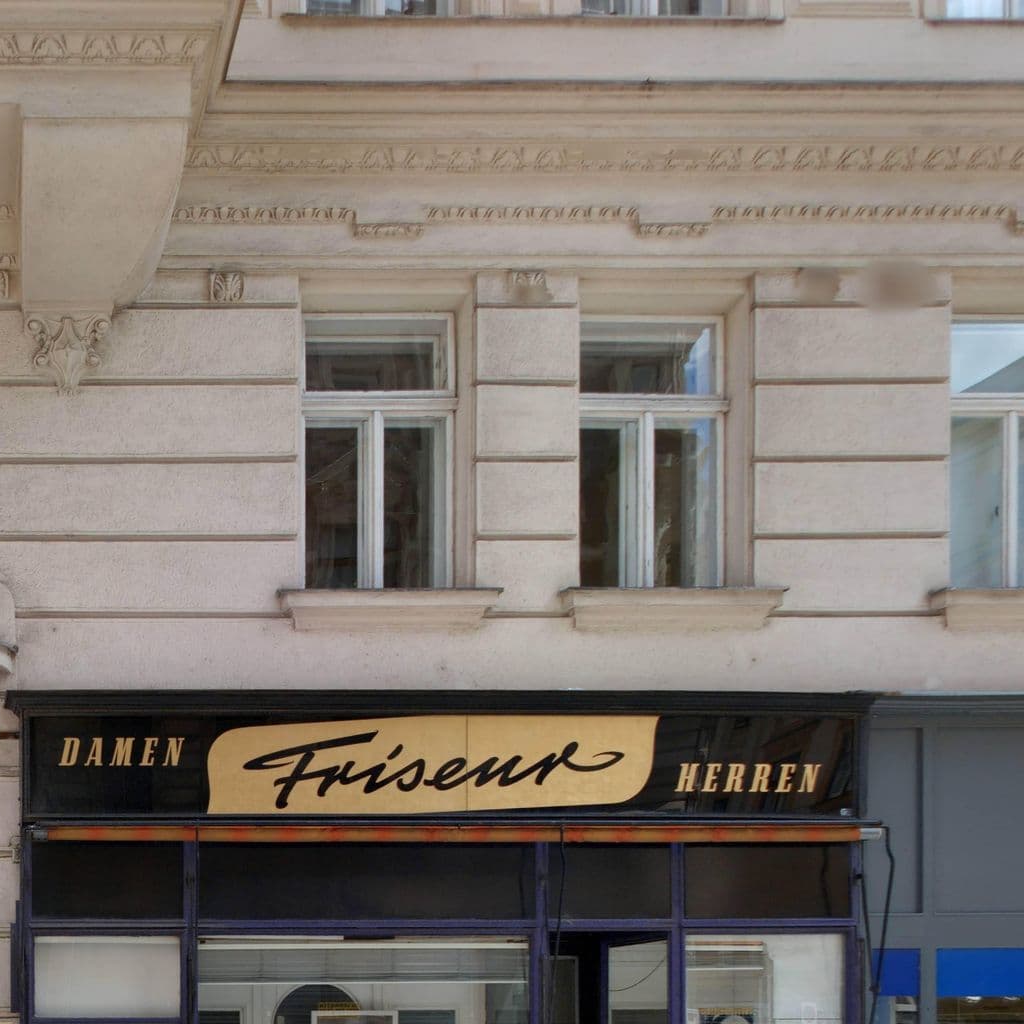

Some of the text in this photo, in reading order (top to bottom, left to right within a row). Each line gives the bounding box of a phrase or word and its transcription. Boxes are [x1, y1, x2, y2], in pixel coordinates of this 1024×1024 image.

[58, 737, 185, 766] DAMEN
[242, 730, 625, 809] Friseur
[674, 763, 822, 792] HERREN
